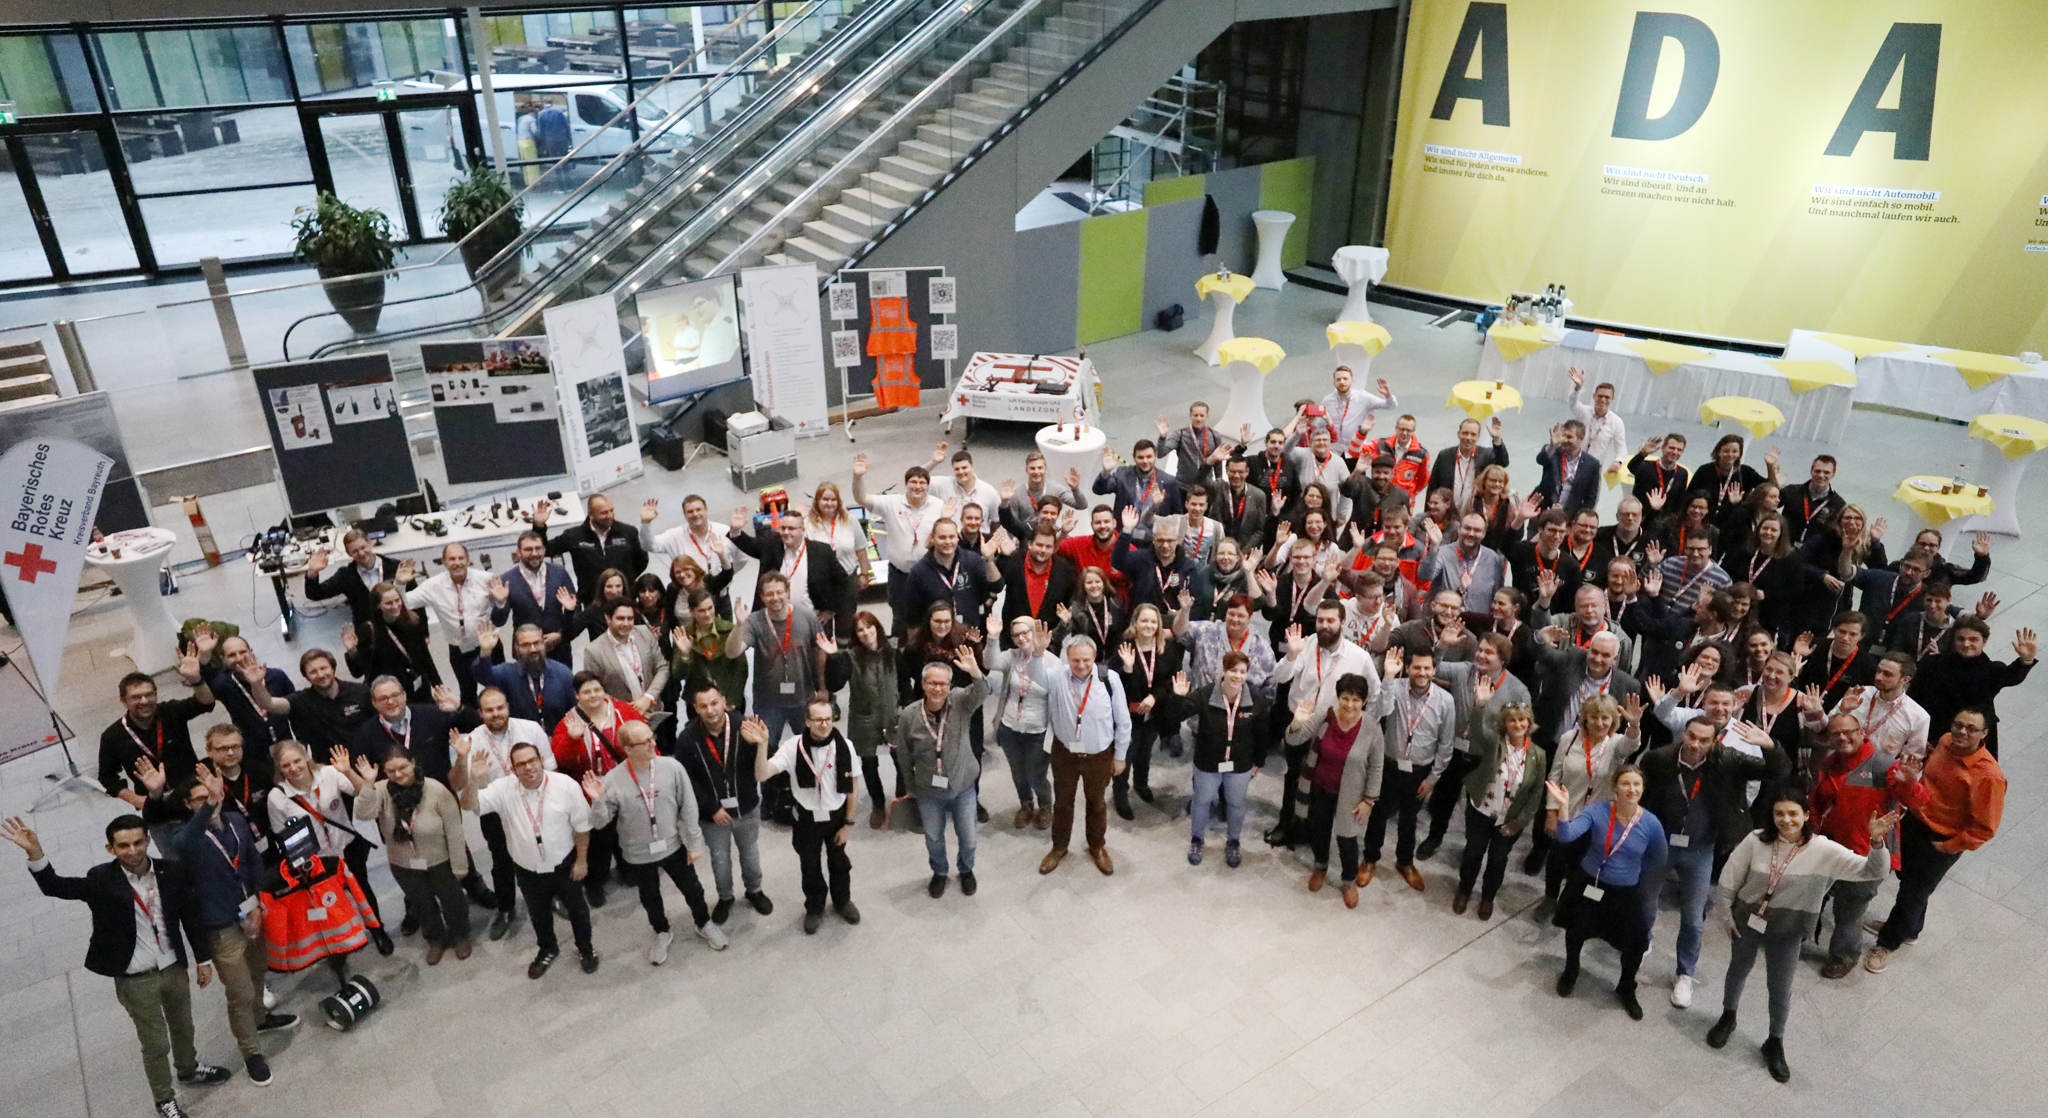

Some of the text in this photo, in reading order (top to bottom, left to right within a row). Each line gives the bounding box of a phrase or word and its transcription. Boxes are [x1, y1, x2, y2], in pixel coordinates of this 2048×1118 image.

[1430, 1, 1942, 161] A D A
[1426, 145, 1520, 163] Wir sind nicht Allgemein.
[1423, 164, 1507, 182] Und immer für dich da.
[1425, 155, 1550, 177] Wir sind für jeden etwas anderes.
[1606, 166, 1706, 183] Wir sind nicht Deutsch.
[1604, 177, 1619, 185] Wir
[1621, 179, 1640, 188] sind
[1641, 181, 1673, 191] überall.
[1676, 185, 1695, 193] Und
[1814, 186, 1938, 200] Wir sind nicht Automobil.
[1600, 187, 1737, 207] Grenzen machen wir nicht halt.
[1811, 197, 1830, 205] Wir
[1831, 198, 1852, 206] sind
[1853, 199, 1889, 208] einfach
[1903, 202, 1935, 211] mobil.
[1808, 207, 1960, 223] Und manchmal laufen wir auch.
[11, 443, 50, 532] Bayerisches
[73, 460, 107, 546] Kreisverband Bayreuth
[30, 493, 55, 536] Rotes
[48, 499, 73, 540] Kreuz
